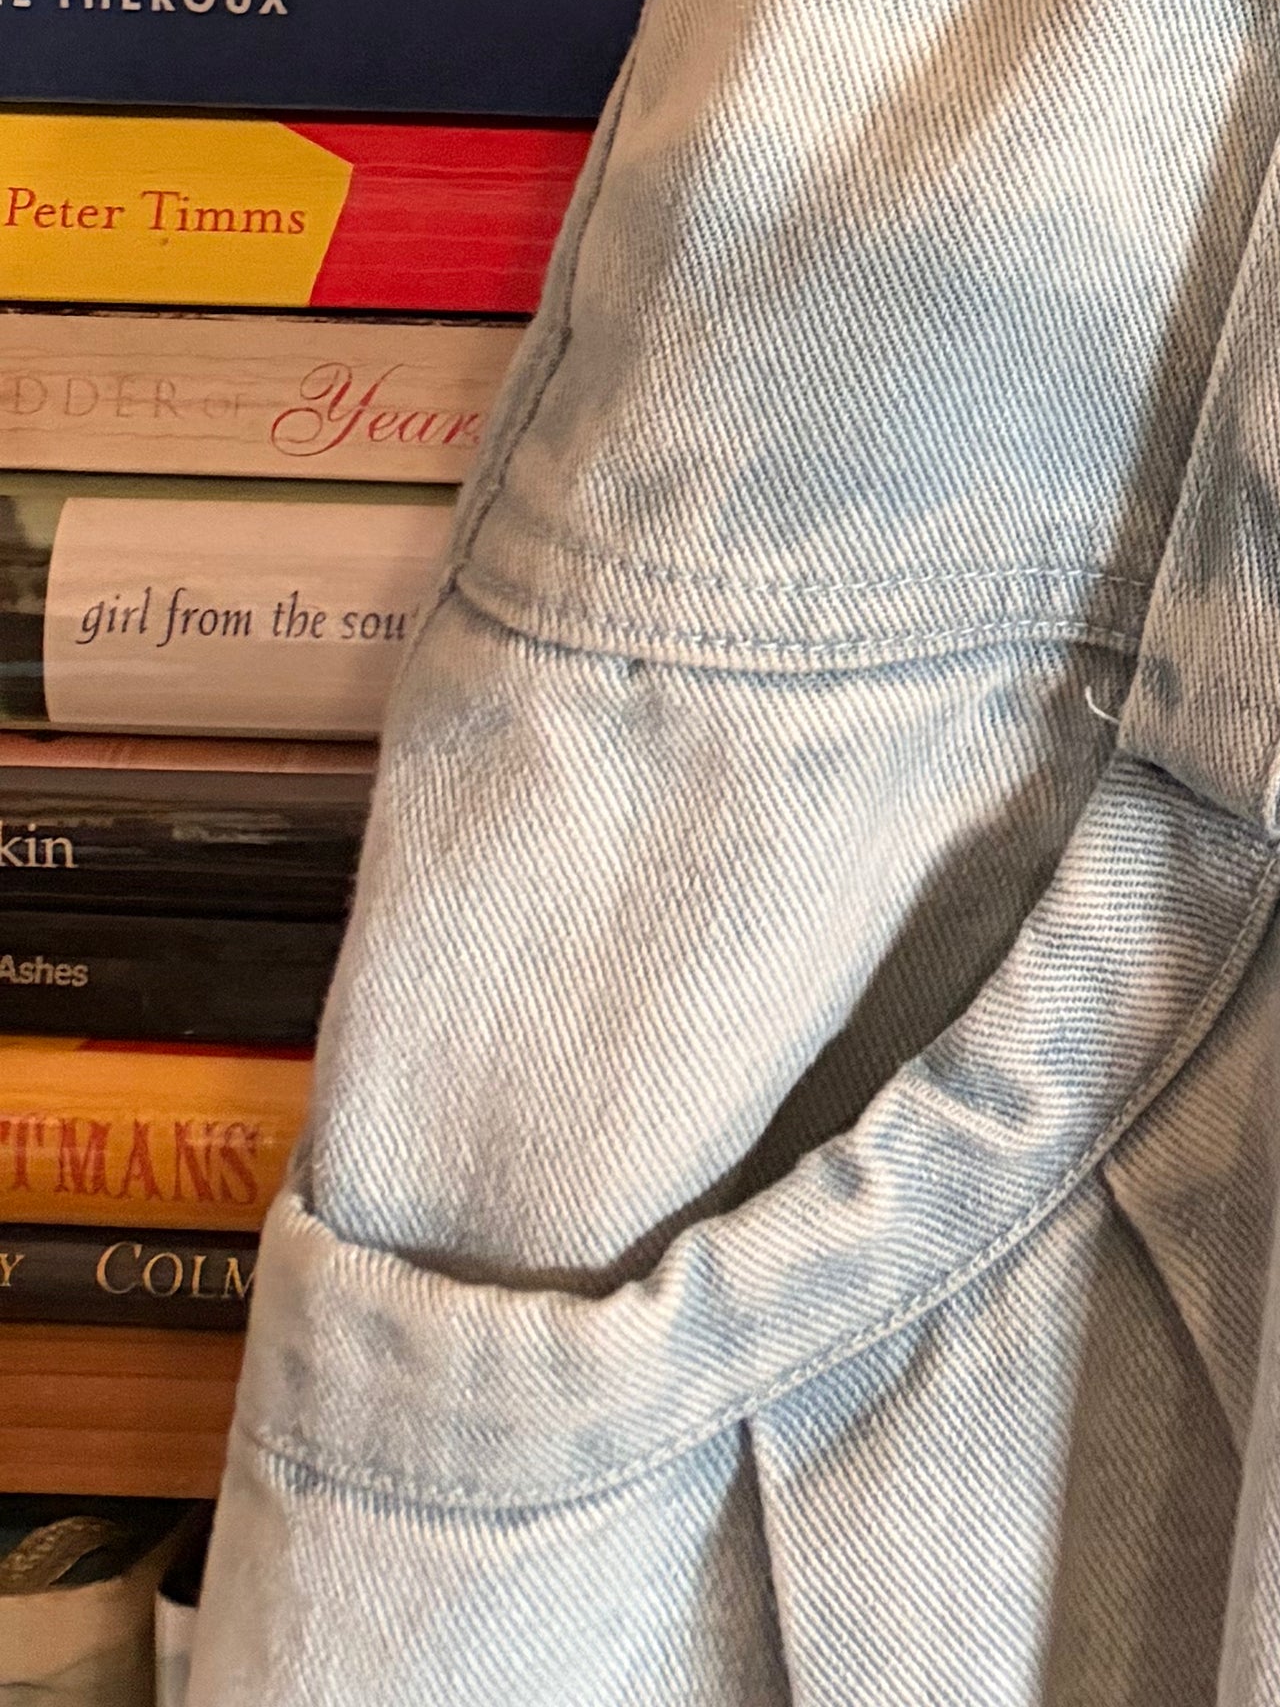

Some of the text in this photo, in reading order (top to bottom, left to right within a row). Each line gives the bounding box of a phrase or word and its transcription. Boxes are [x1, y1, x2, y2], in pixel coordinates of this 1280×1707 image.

[3, 188, 307, 238] Peter Timms
[75, 586, 328, 648] girl from the
